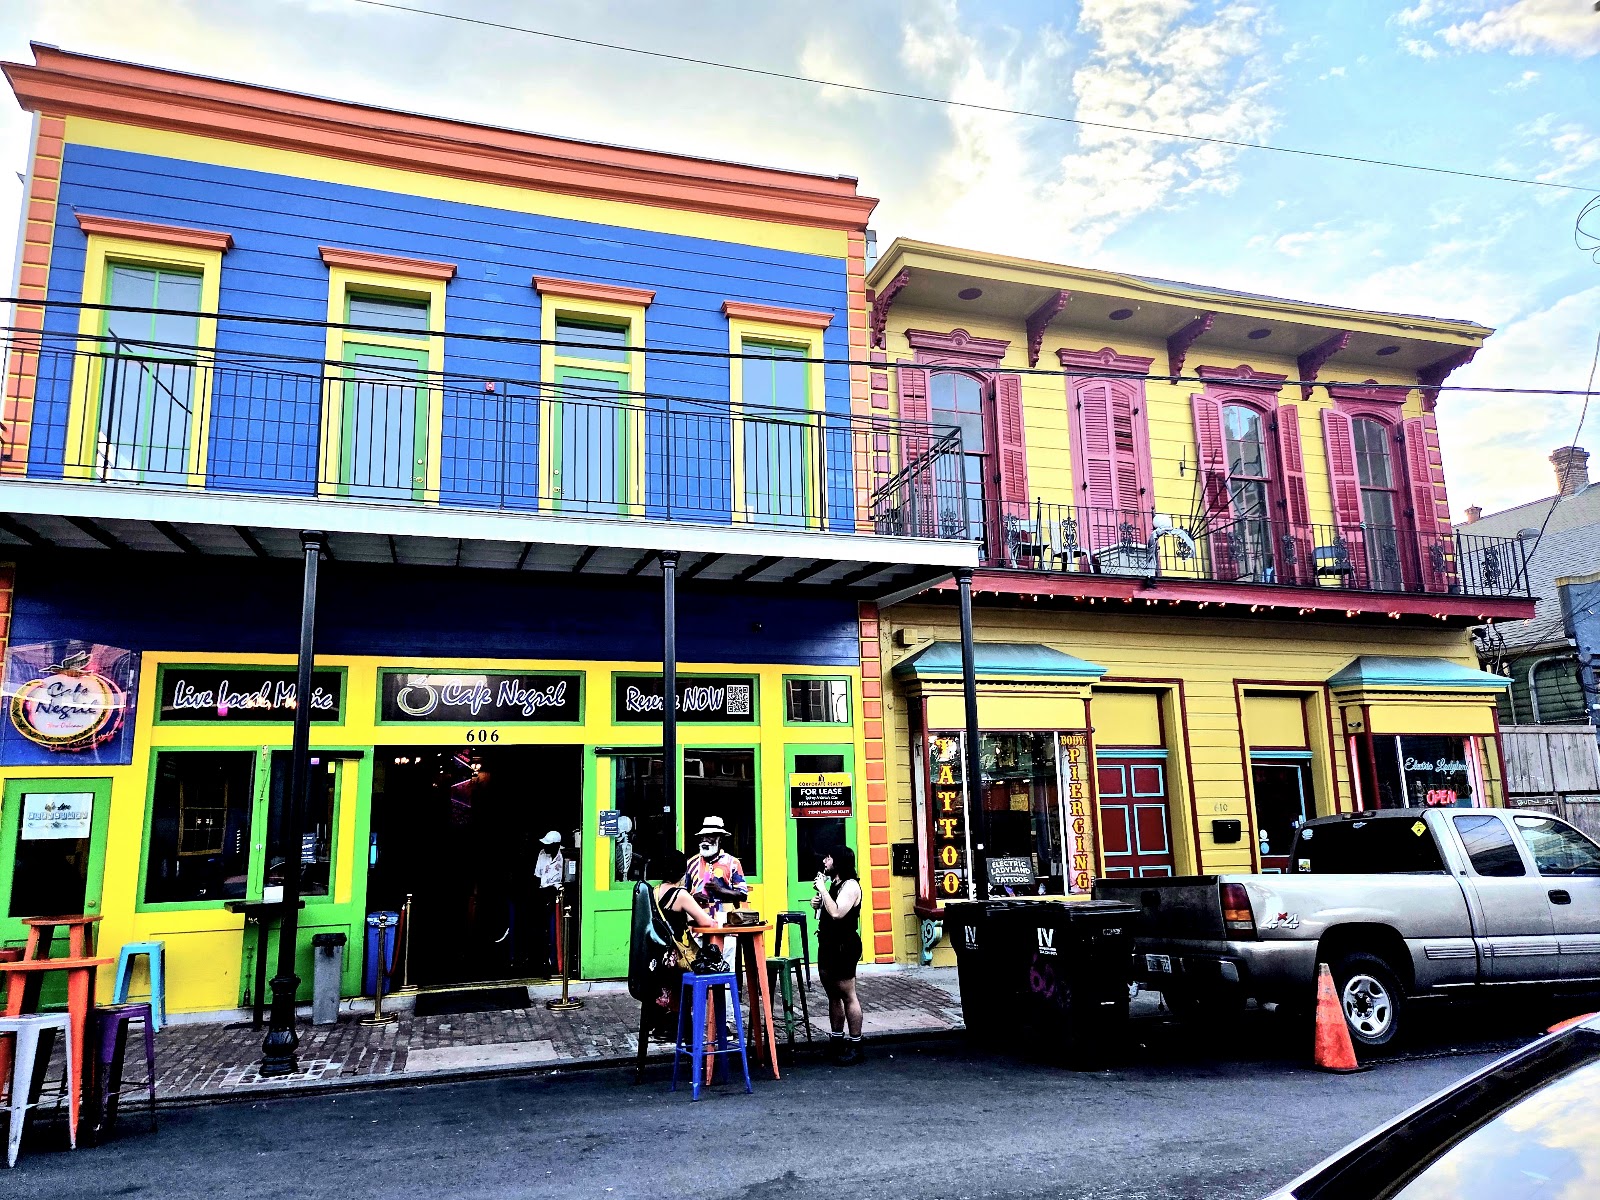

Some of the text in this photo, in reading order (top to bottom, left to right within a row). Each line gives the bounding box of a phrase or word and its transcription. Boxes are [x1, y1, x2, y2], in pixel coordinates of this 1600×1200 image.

[173, 680, 333, 710] Live Local Mic
[441, 679, 566, 716] Cafe Negril
[626, 686, 724, 712] Reser NOW
[466, 729, 499, 742] 606
[1427, 789, 1457, 805] OPEN
[935, 738, 960, 894] TATTOO
[1067, 748, 1089, 890] PIERCING
[991, 867, 1030, 875] LADYLAND
